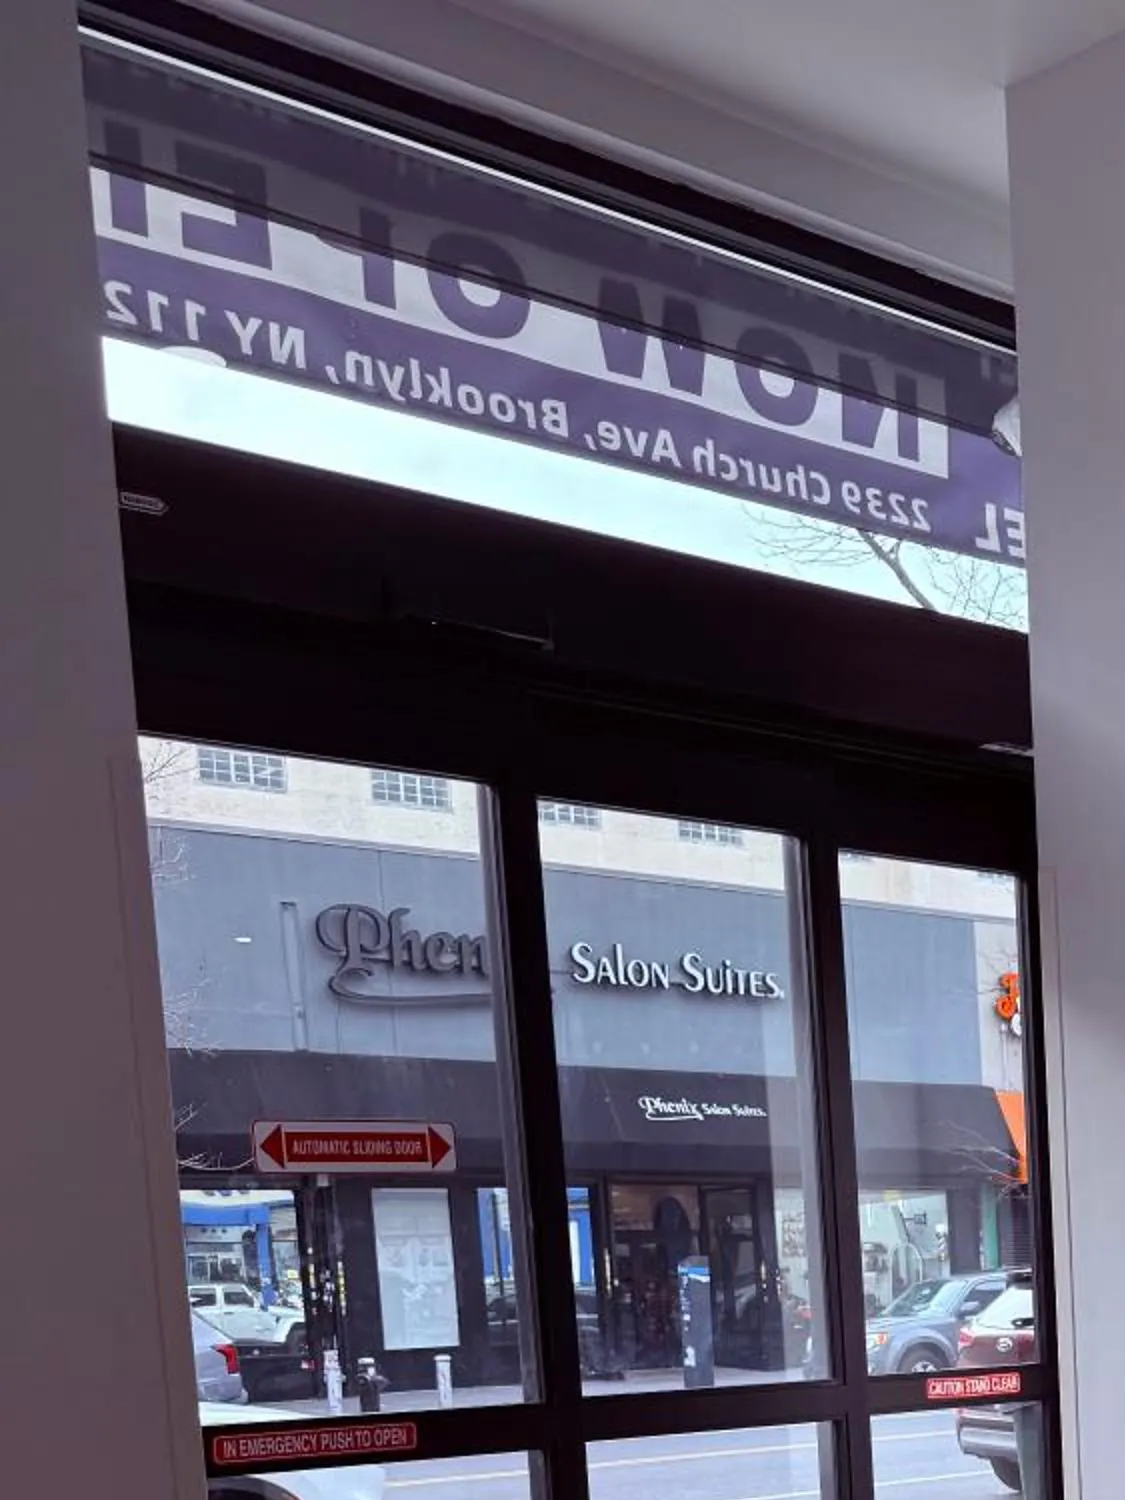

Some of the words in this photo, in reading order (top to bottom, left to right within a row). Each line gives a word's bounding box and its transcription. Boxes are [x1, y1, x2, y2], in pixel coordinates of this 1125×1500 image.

[315, 903, 490, 1006] Phen
[638, 1094, 704, 1121] Phenix
[292, 1139, 351, 1155] AUTOMATIC
[352, 1139, 393, 1155] SLIDING
[394, 1139, 423, 1155] DOOR
[929, 1379, 964, 1396] CAUTION
[965, 1377, 991, 1394] STAND
[992, 1374, 1018, 1392] CLEAR
[223, 1440, 237, 1458] IN
[239, 1433, 317, 1457] EMERGENCY
[321, 1431, 353, 1450] PUSH
[355, 1430, 371, 1447] TO
[374, 1427, 407, 1446] OPEN
